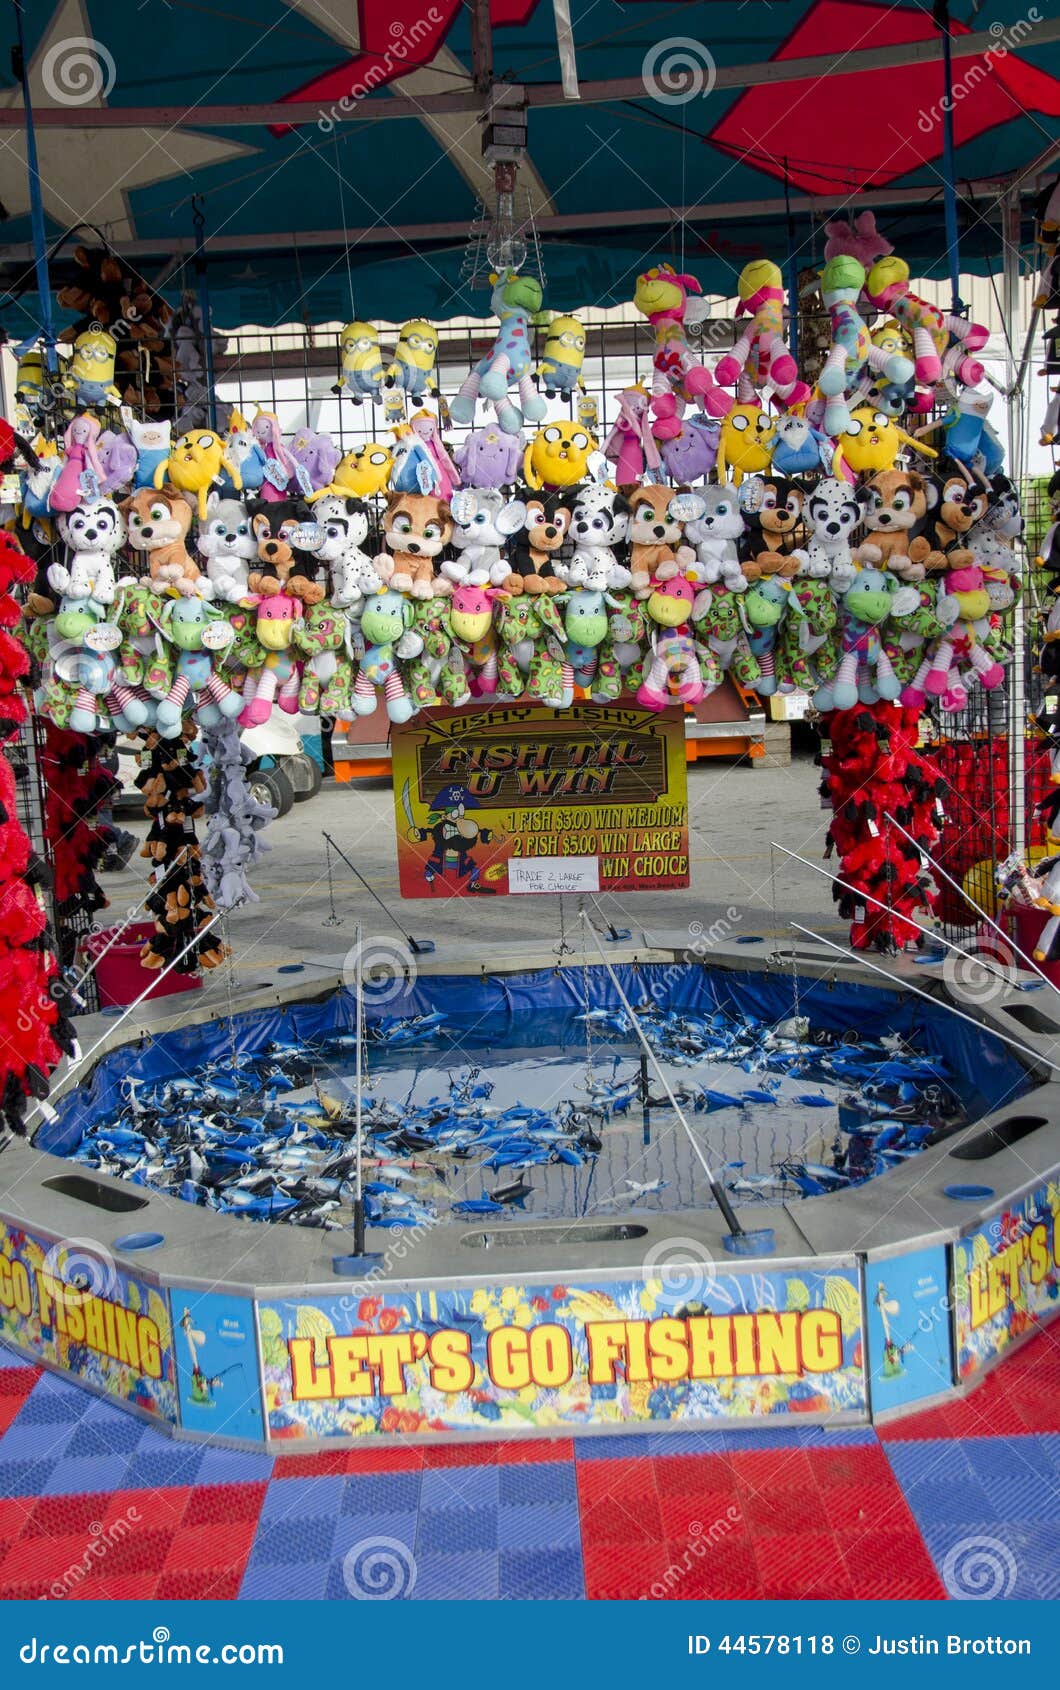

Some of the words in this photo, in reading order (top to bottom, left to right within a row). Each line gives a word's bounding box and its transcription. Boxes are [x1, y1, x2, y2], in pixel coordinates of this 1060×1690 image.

[450, 708, 532, 733] FISHY
[553, 707, 638, 726] FISHY
[436, 743, 555, 774] FISH
[566, 738, 649, 769] TIL
[466, 770, 504, 799] U
[516, 767, 617, 797] WIN
[507, 811, 518, 833] 1
[519, 810, 555, 832] FISH
[594, 808, 625, 830] WIN
[626, 805, 688, 829] MEDIUM
[512, 837, 523, 857] 2
[526, 834, 559, 856] FISH
[562, 833, 598, 857] $5.00
[600, 832, 630, 854] WIN
[632, 830, 682, 853] LARGE
[514, 869, 544, 882] TRADE
[547, 872, 557, 881] 2
[559, 872, 584, 881] LARGE
[602, 856, 631, 878] WIN
[633, 855, 688, 877] CHOICE
[547, 882, 577, 891] CHOICE
[968, 1222, 1050, 1332] LET'S
[0, 1253, 32, 1317] GO
[35, 1268, 163, 1379] FISHING
[288, 1328, 475, 1400] LET'S
[488, 1323, 574, 1390] GO
[585, 1308, 843, 1385] FISHING
